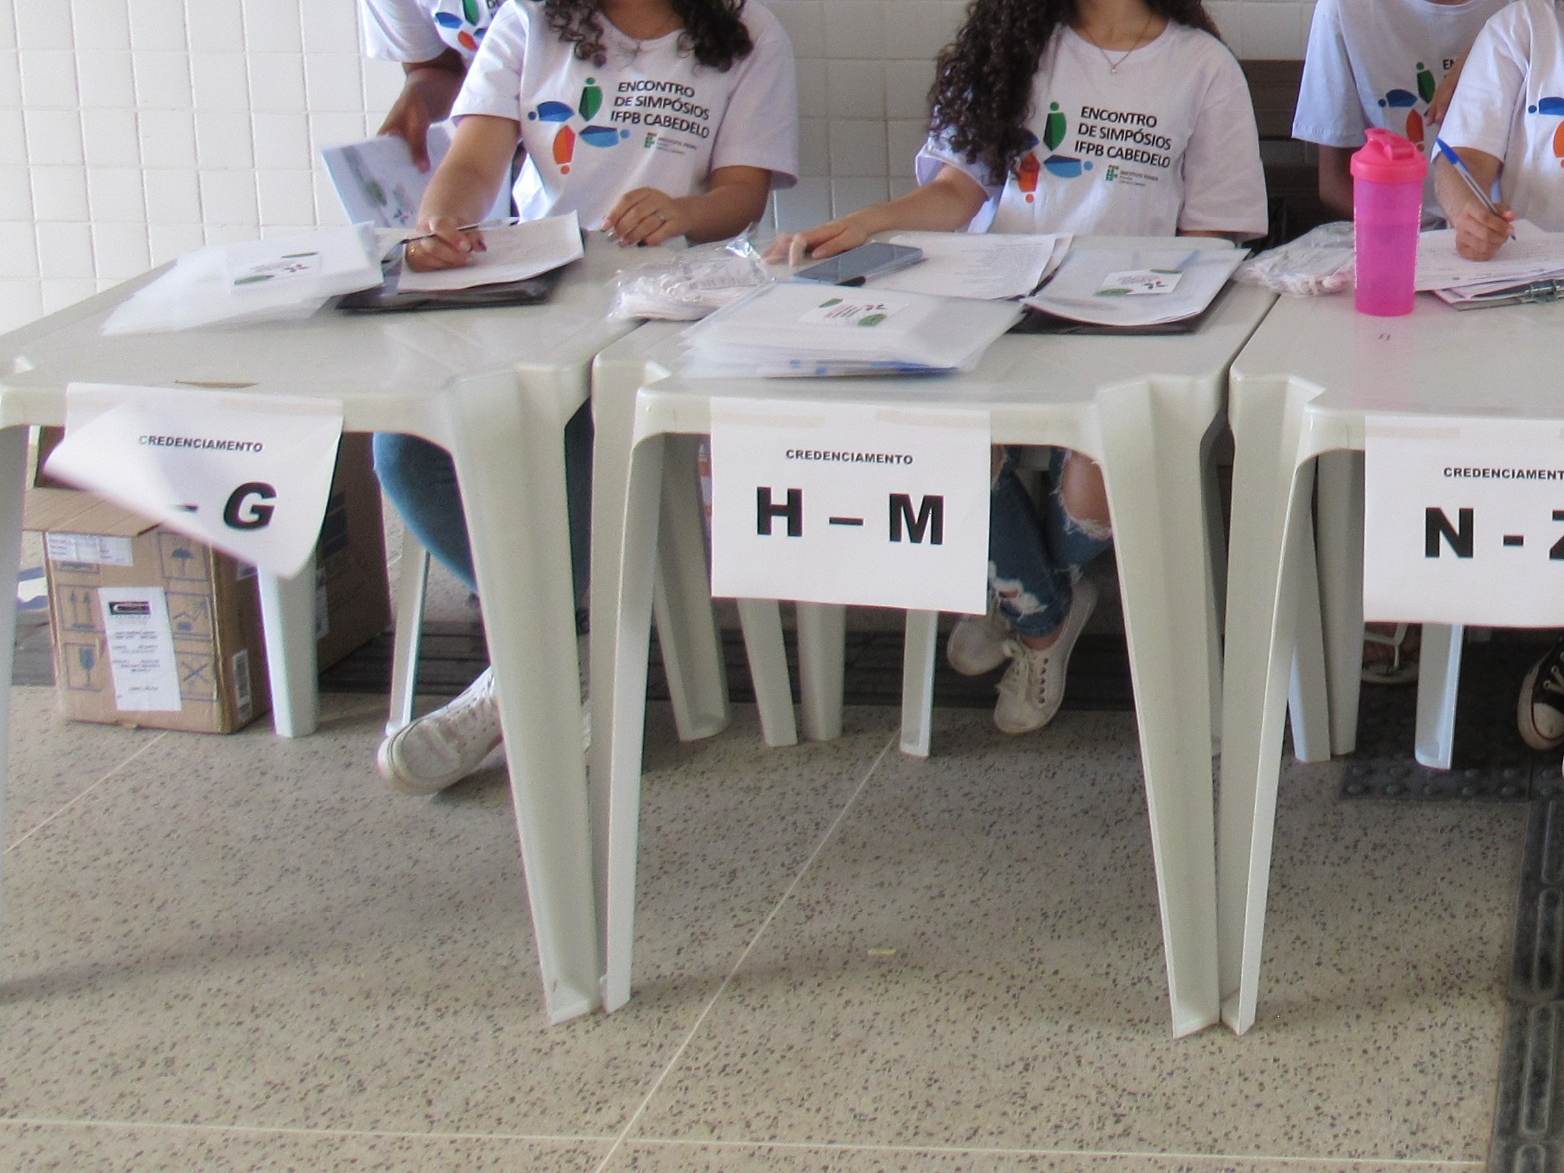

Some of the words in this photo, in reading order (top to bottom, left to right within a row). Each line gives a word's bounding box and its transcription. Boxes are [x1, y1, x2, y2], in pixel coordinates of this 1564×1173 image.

[618, 81, 695, 98] ENCONTRO
[614, 96, 633, 108] DE
[635, 95, 710, 121] SIMPÓSIOS
[1080, 106, 1157, 127] ENCONTRO
[610, 111, 641, 125] IFPB
[643, 113, 710, 139] CABEDELO
[1078, 123, 1097, 137] DE
[1100, 126, 1172, 150] SIMPÓSIOS
[1074, 140, 1104, 156] IFPB
[1107, 146, 1171, 168] CABEDELO
[138, 435, 263, 453] CREDENCIAMENTO
[786, 449, 913, 465] CREDENCIAMENTO
[223, 481, 278, 531] G
[756, 486, 802, 537] H
[888, 492, 944, 545] M
[1425, 507, 1474, 559] N
